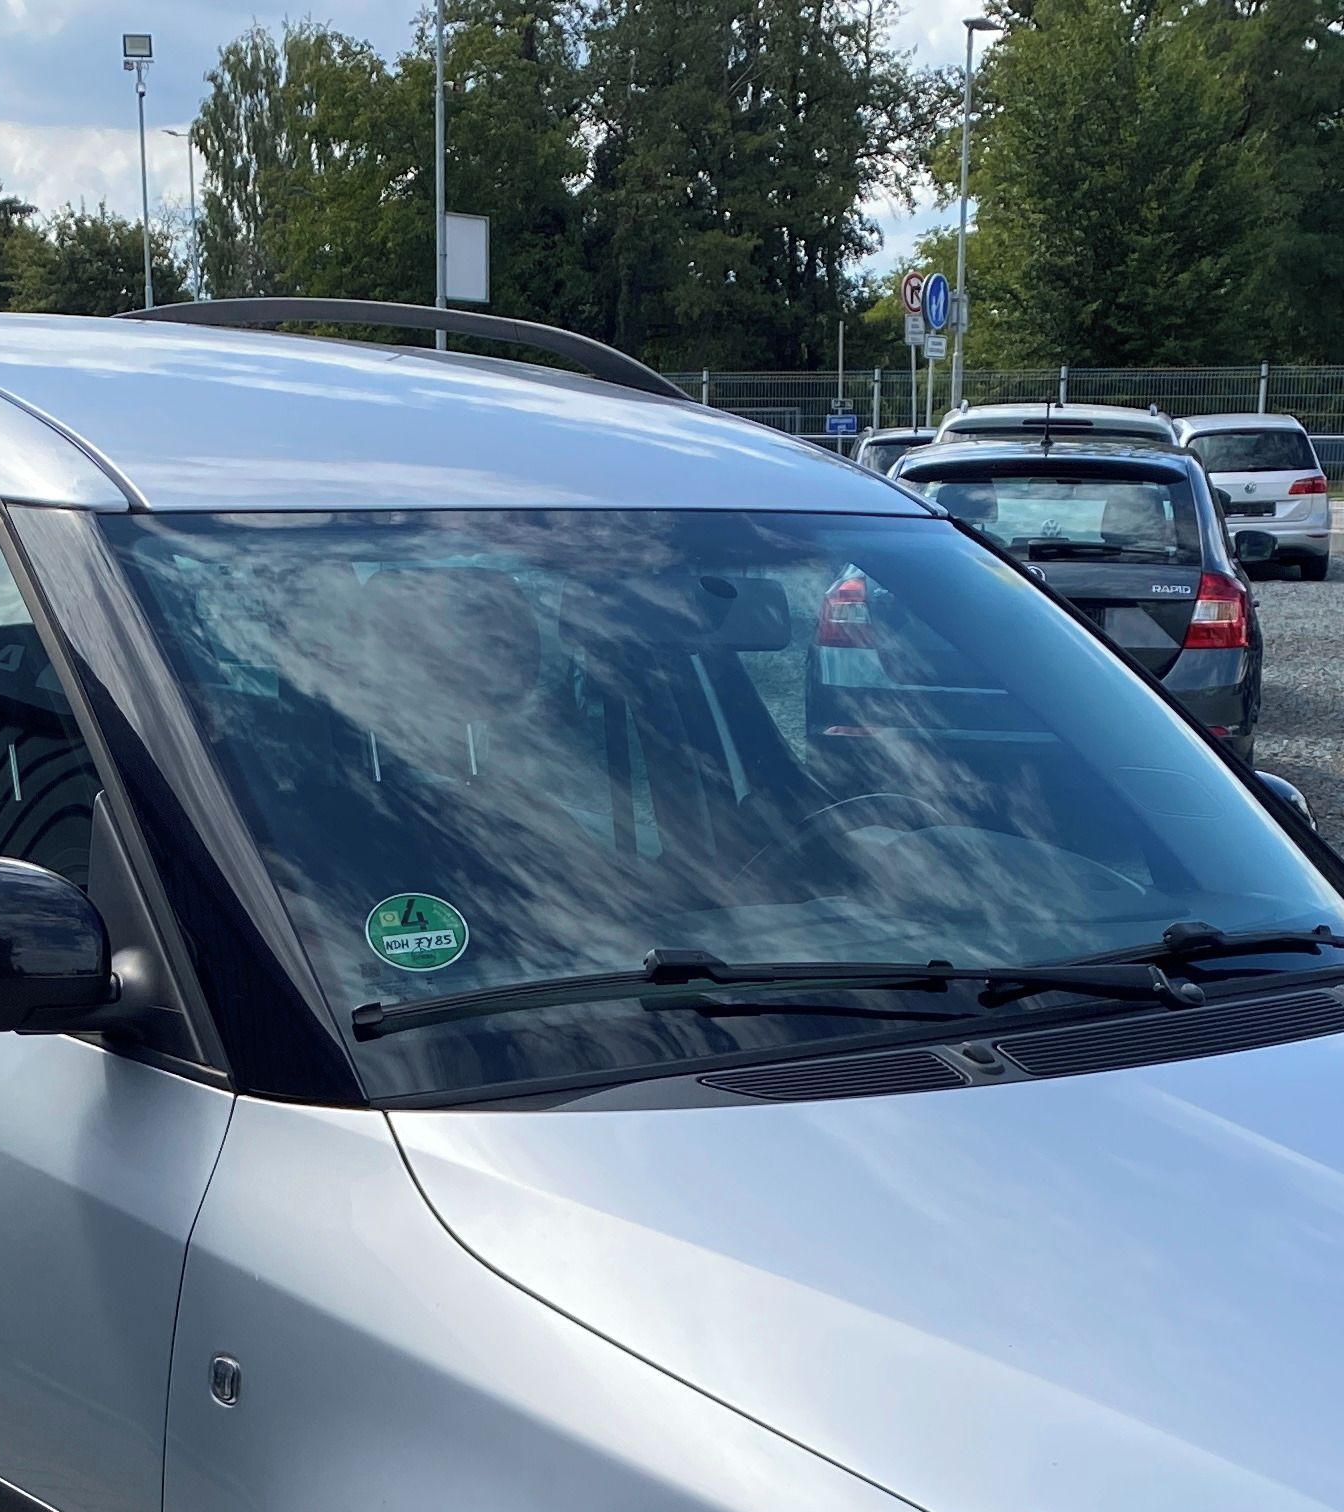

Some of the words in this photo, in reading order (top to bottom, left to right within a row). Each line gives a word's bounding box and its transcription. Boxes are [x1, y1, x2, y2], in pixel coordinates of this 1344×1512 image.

[1152, 584, 1191, 594] RAPID
[401, 898, 429, 931] 4
[434, 934, 453, 947] 85
